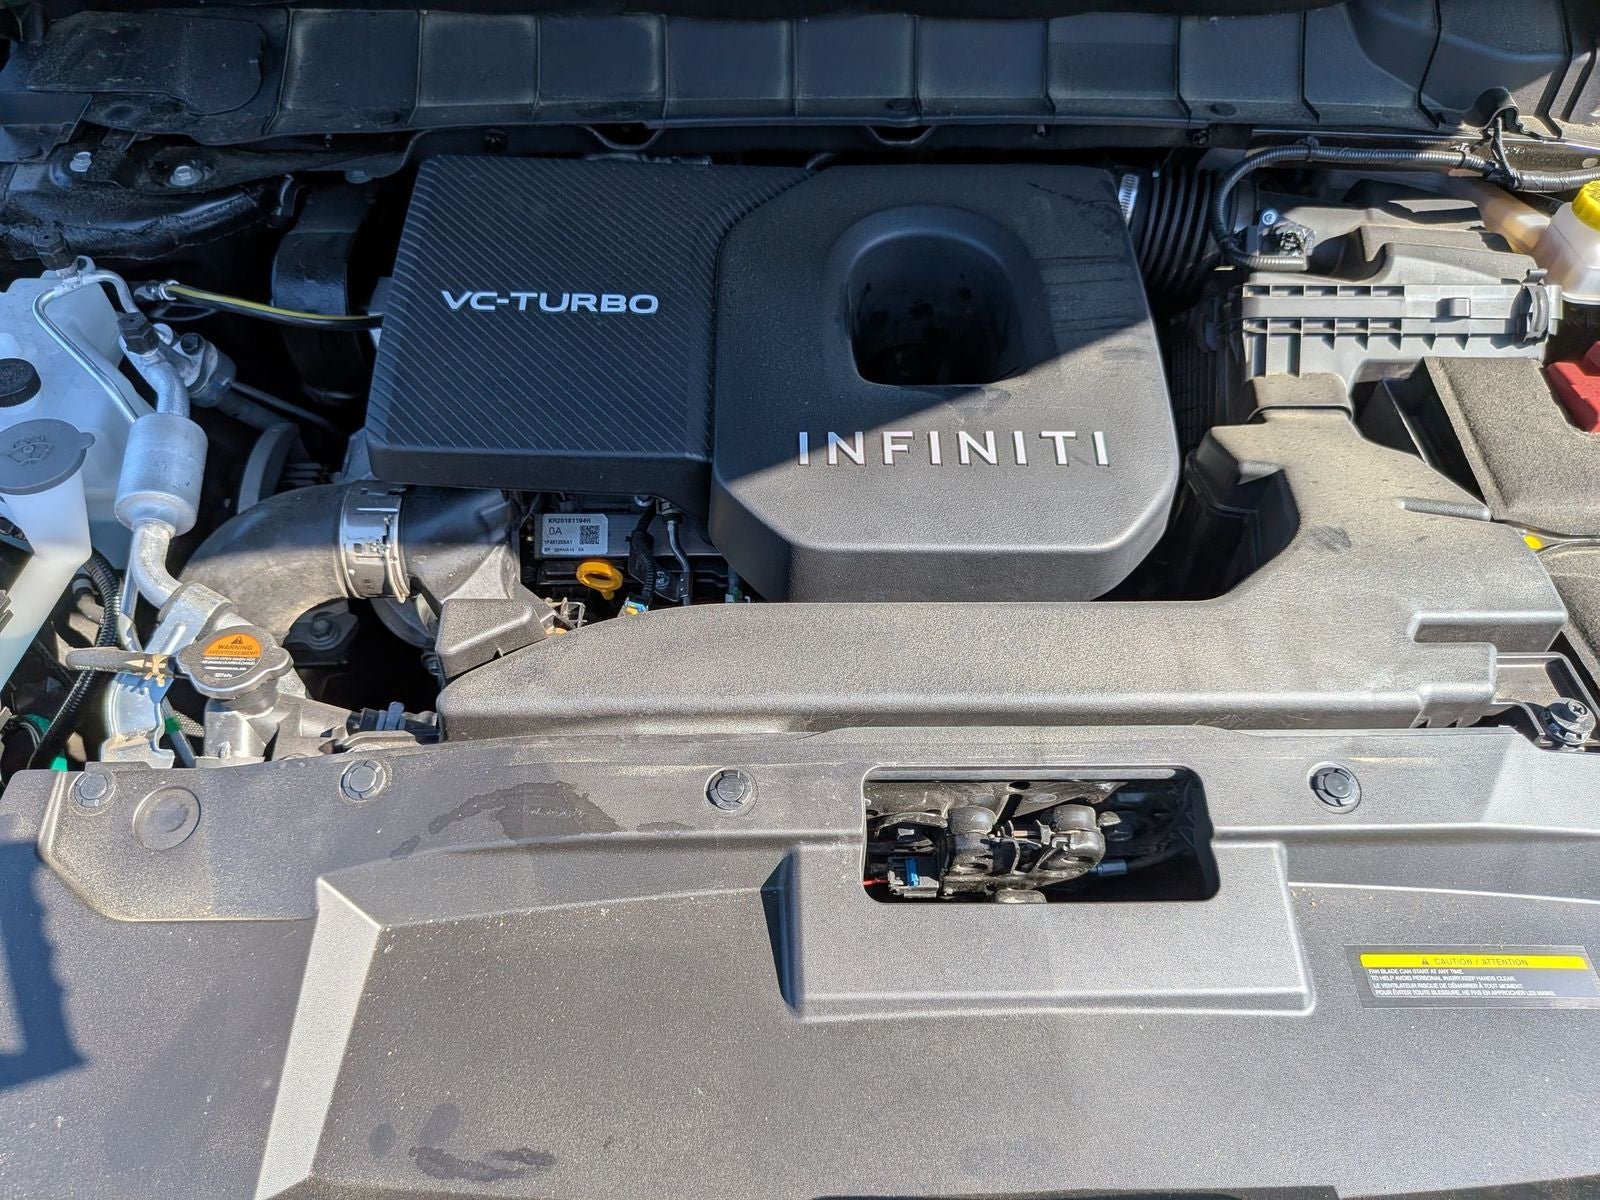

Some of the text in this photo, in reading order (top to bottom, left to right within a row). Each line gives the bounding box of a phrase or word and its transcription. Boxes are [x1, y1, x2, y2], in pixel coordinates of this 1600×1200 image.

[441, 291, 659, 314] VC-TURBO
[798, 430, 1110, 467] INFINITI
[1434, 958, 1473, 966] CAUTION
[1482, 958, 1529, 966] ATTENTION
